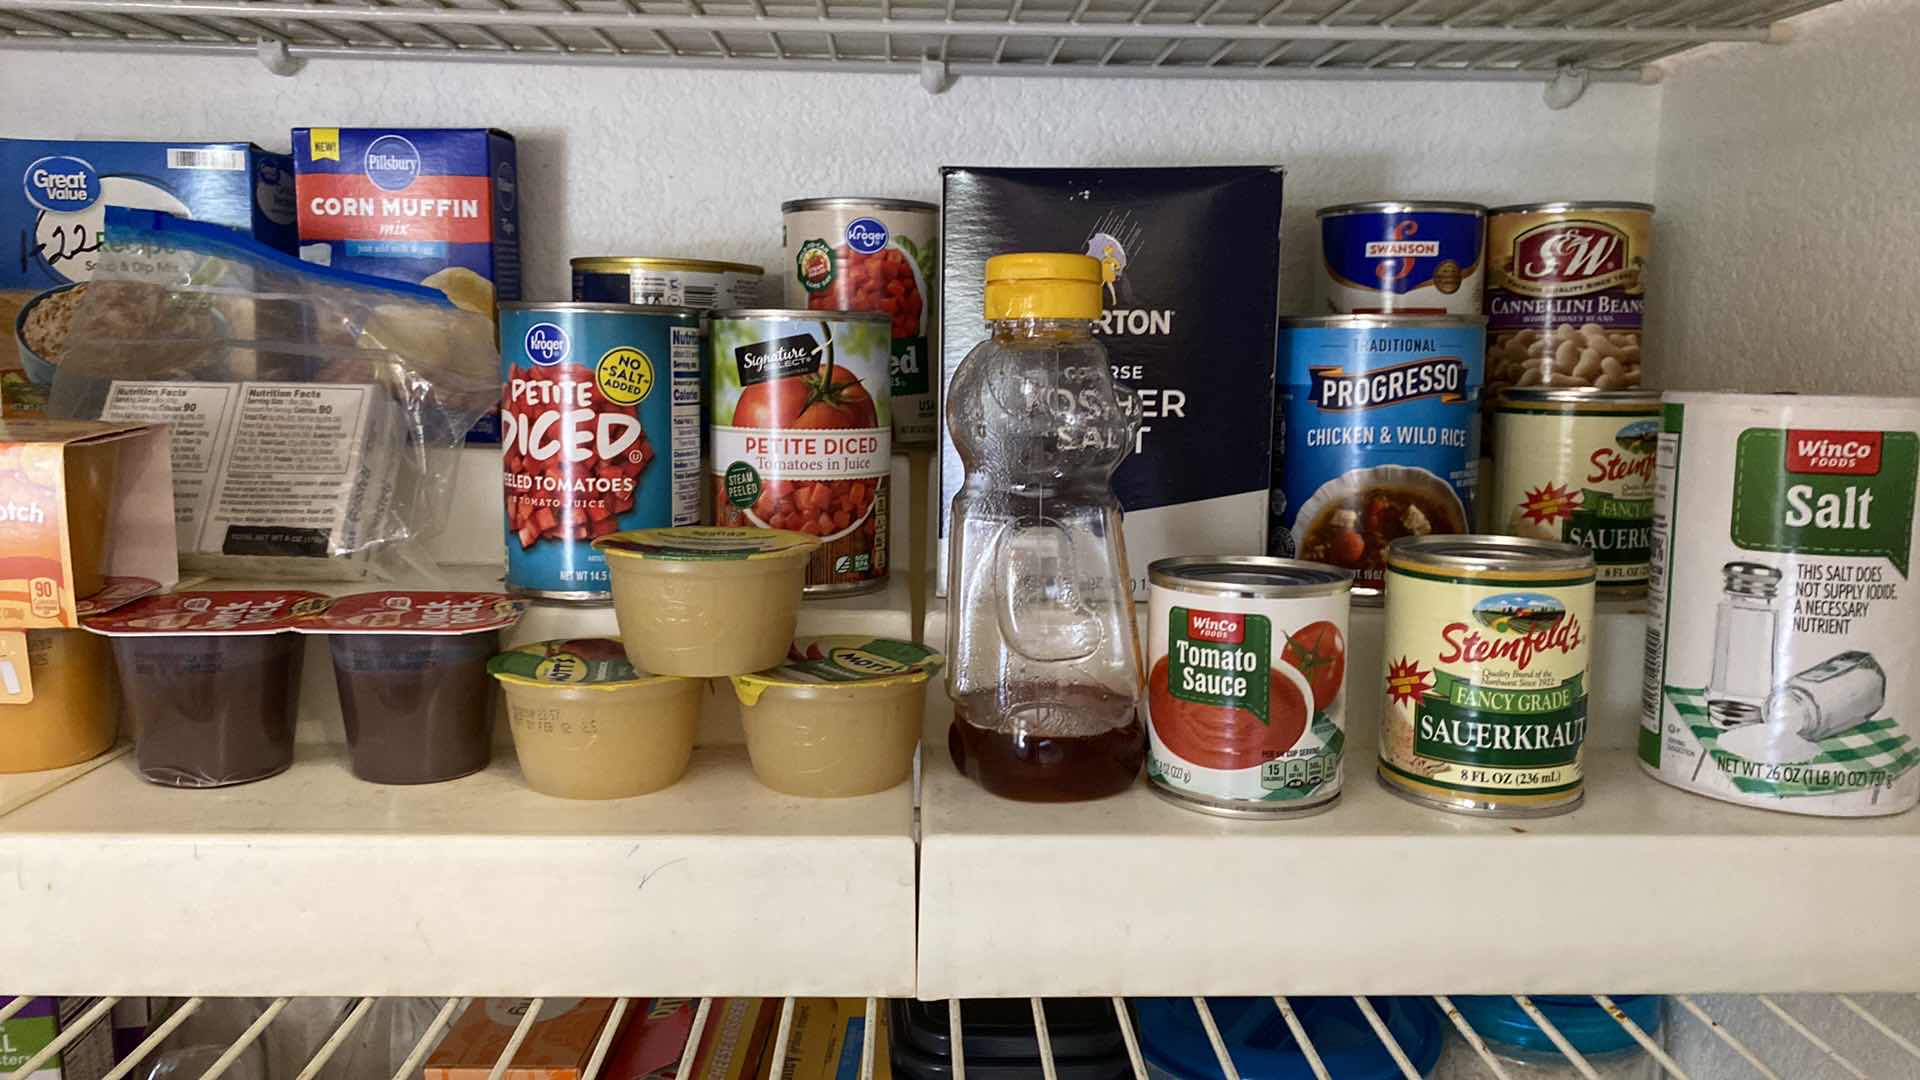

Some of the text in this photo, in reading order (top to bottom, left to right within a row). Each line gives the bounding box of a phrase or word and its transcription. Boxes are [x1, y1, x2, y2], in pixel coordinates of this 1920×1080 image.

[315, 142, 338, 152] NEW!
[369, 155, 417, 175] Pillsbury
[33, 169, 87, 189] Great
[47, 187, 88, 201] Value
[311, 197, 479, 218] CORN MUFFIN
[380, 223, 410, 237] mix
[849, 225, 885, 246] Kroger
[1369, 243, 1435, 256] SWANSON
[1491, 297, 1593, 314] CANNELLINI
[531, 331, 564, 358] Kroger
[618, 354, 641, 370] NO
[744, 347, 808, 371] Signature
[608, 366, 645, 385] SALT
[116, 387, 187, 397] Nutrition Facts
[249, 389, 321, 399] Nutrition Facts
[511, 378, 593, 407] PETITE
[604, 378, 641, 396] ADDED
[1322, 364, 1459, 406] PROGRESSO
[183, 403, 197, 412] 90
[318, 405, 332, 414] 90
[746, 437, 878, 454] PEITE DICED
[1307, 427, 1467, 447] CHICKEN & WILD RICE
[1799, 440, 1871, 459] WinCo
[828, 457, 839, 470] in
[843, 457, 871, 471] Juice
[1810, 458, 1857, 468] FOODS
[534, 475, 633, 493] TOMATOES
[729, 471, 753, 484] STEAM
[729, 482, 758, 497] PEELED
[1785, 484, 1873, 530] Salt
[577, 570, 588, 581] WT
[590, 571, 607, 581] 14.5
[1798, 564, 1882, 582] THIS SALT DOES
[34, 580, 52, 599] 90
[1795, 582, 1818, 597] NOT
[1824, 584, 1863, 600] SUPPLY
[1794, 601, 1869, 618] A NECESSARY
[1193, 616, 1238, 633] WinCo
[1793, 618, 1851, 635] NUTRIENT
[1200, 630, 1227, 638] FOODS
[1440, 613, 1582, 670] Steinfeld's
[1176, 639, 1257, 672] Tomato
[1183, 667, 1247, 697] Sauce
[1457, 687, 1570, 712] FANCY GRADE
[1422, 715, 1585, 750] SAUERKRAUT
[1269, 764, 1280, 775] 15
[1460, 769, 1561, 786] 8 FL OZ (236 mL)
[1717, 756, 1740, 771] NET
[1743, 762, 1763, 778] WT
[1766, 764, 1781, 780] 26
[1783, 766, 1800, 783] OZ
[1816, 768, 1831, 785] LB
[1832, 770, 1845, 786] 10
[1848, 770, 1867, 786] OZ)
